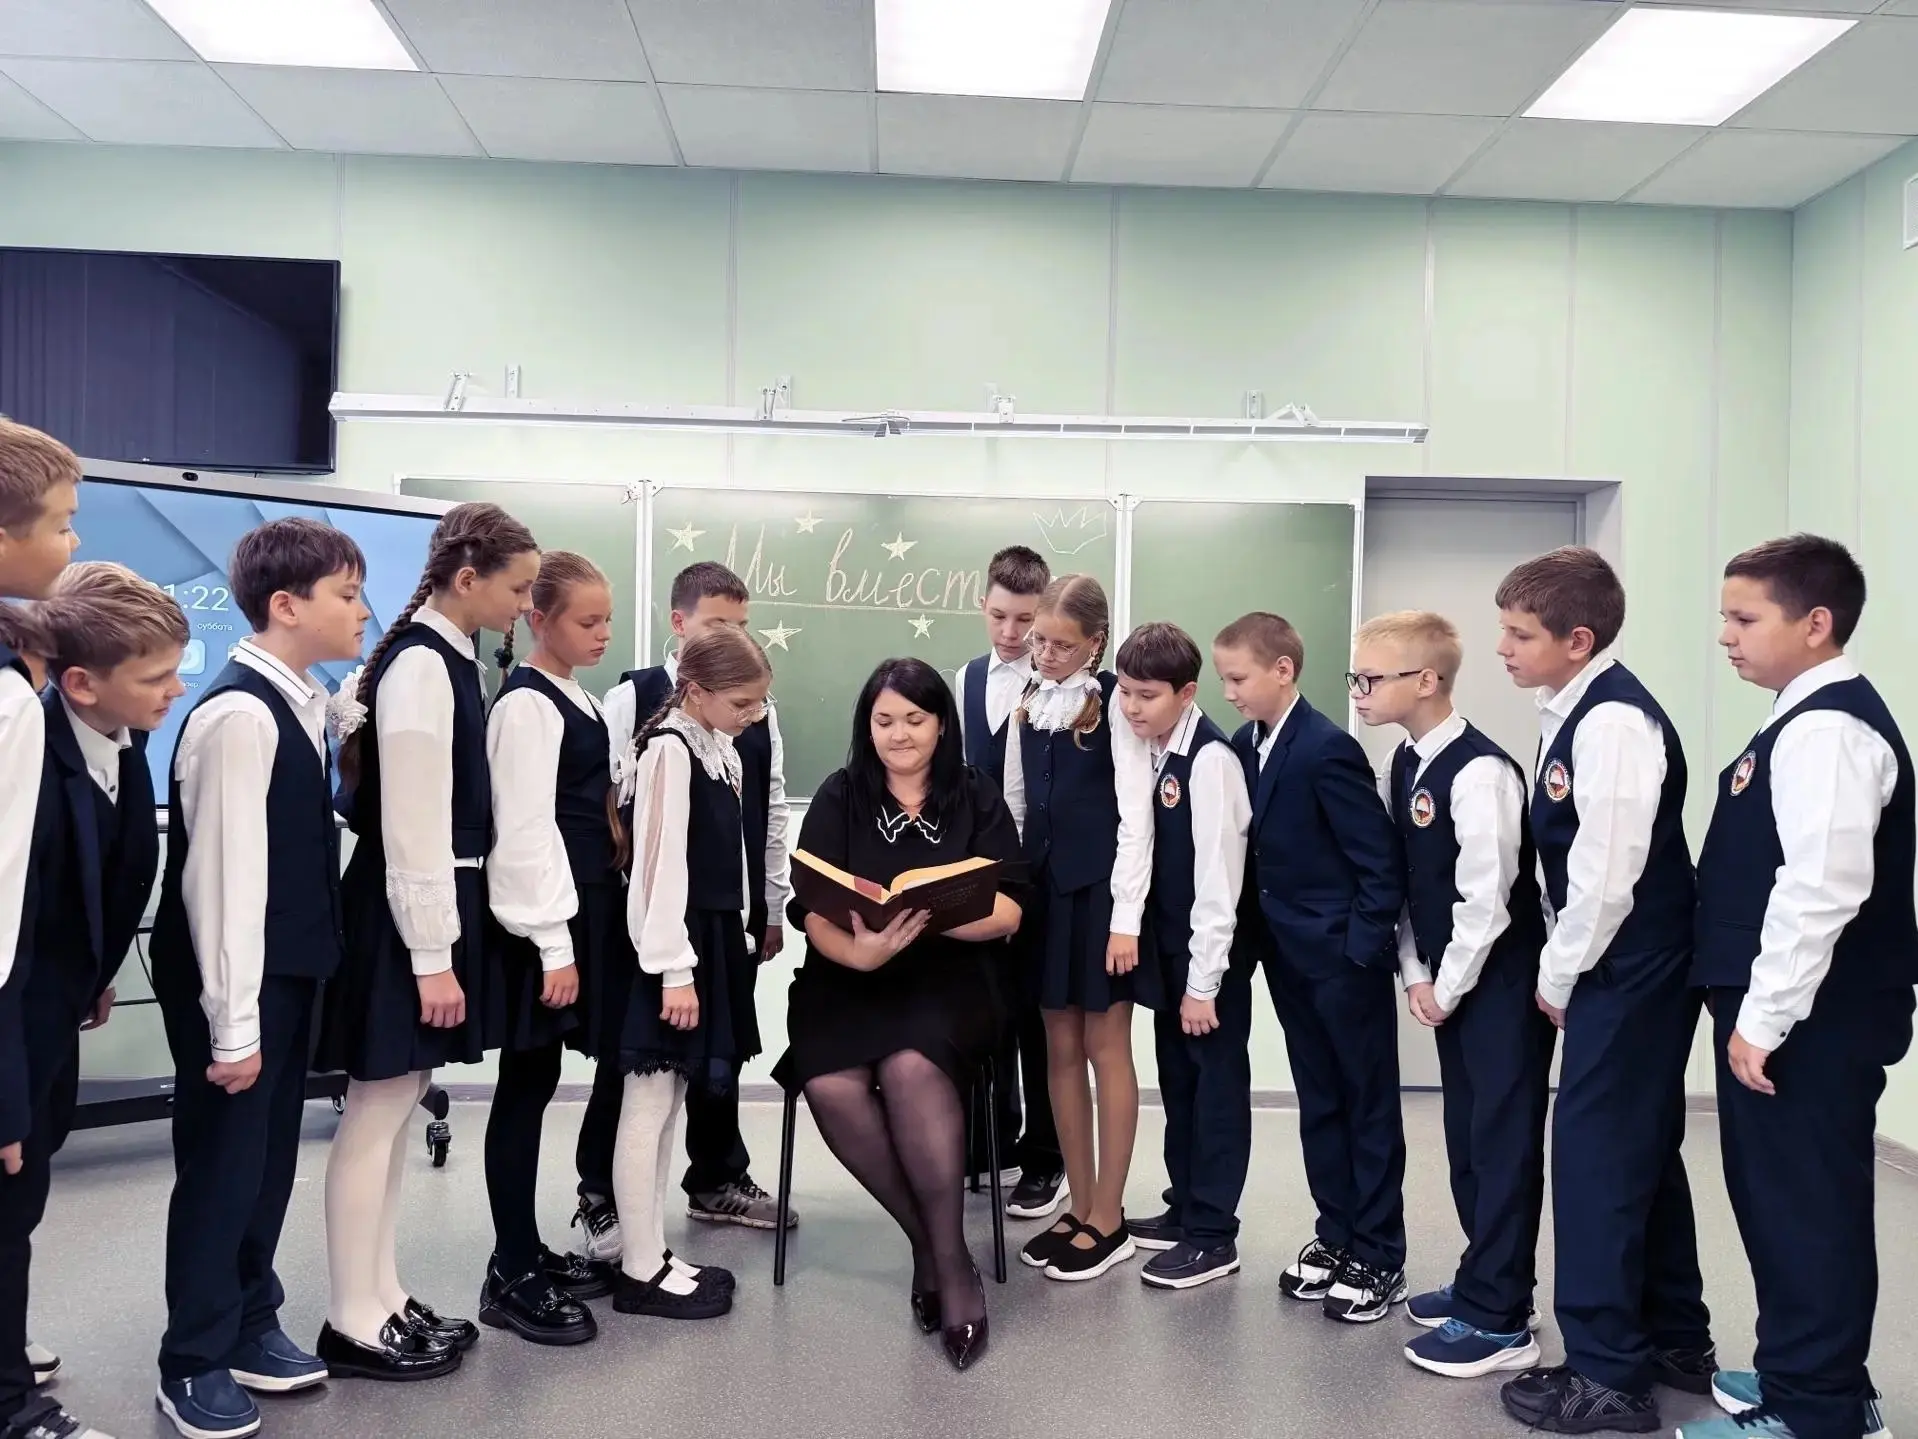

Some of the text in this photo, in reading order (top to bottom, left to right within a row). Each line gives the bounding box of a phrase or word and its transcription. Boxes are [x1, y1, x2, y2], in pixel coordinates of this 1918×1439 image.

[726, 523, 984, 610] Мы вмест
[147, 581, 229, 611] 1:22
[197, 622, 233, 631] суббота
